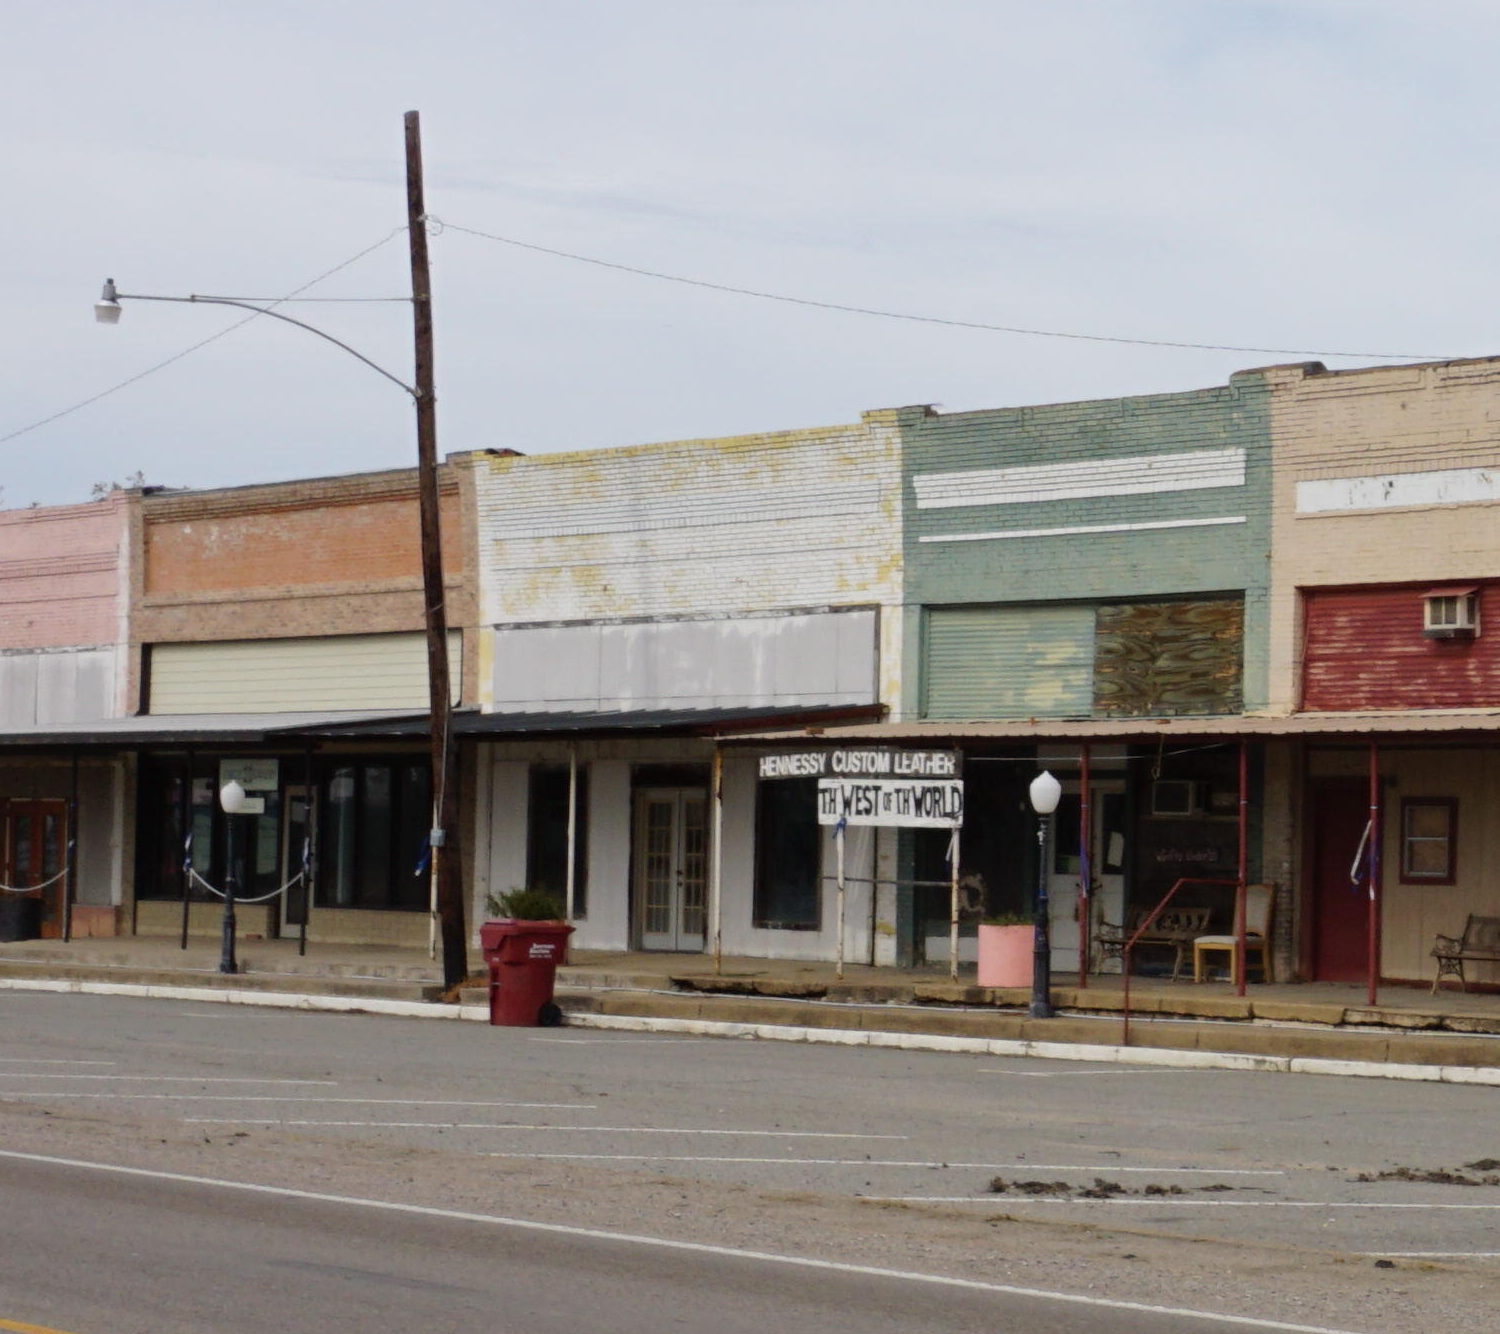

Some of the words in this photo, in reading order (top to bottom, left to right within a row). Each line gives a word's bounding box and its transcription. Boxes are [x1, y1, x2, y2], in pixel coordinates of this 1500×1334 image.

[760, 752, 826, 777] HENNESSY
[832, 751, 890, 773] CUSTOM
[894, 752, 955, 774] LEATHER
[841, 785, 882, 816] WEST
[911, 786, 963, 818] WORLD
